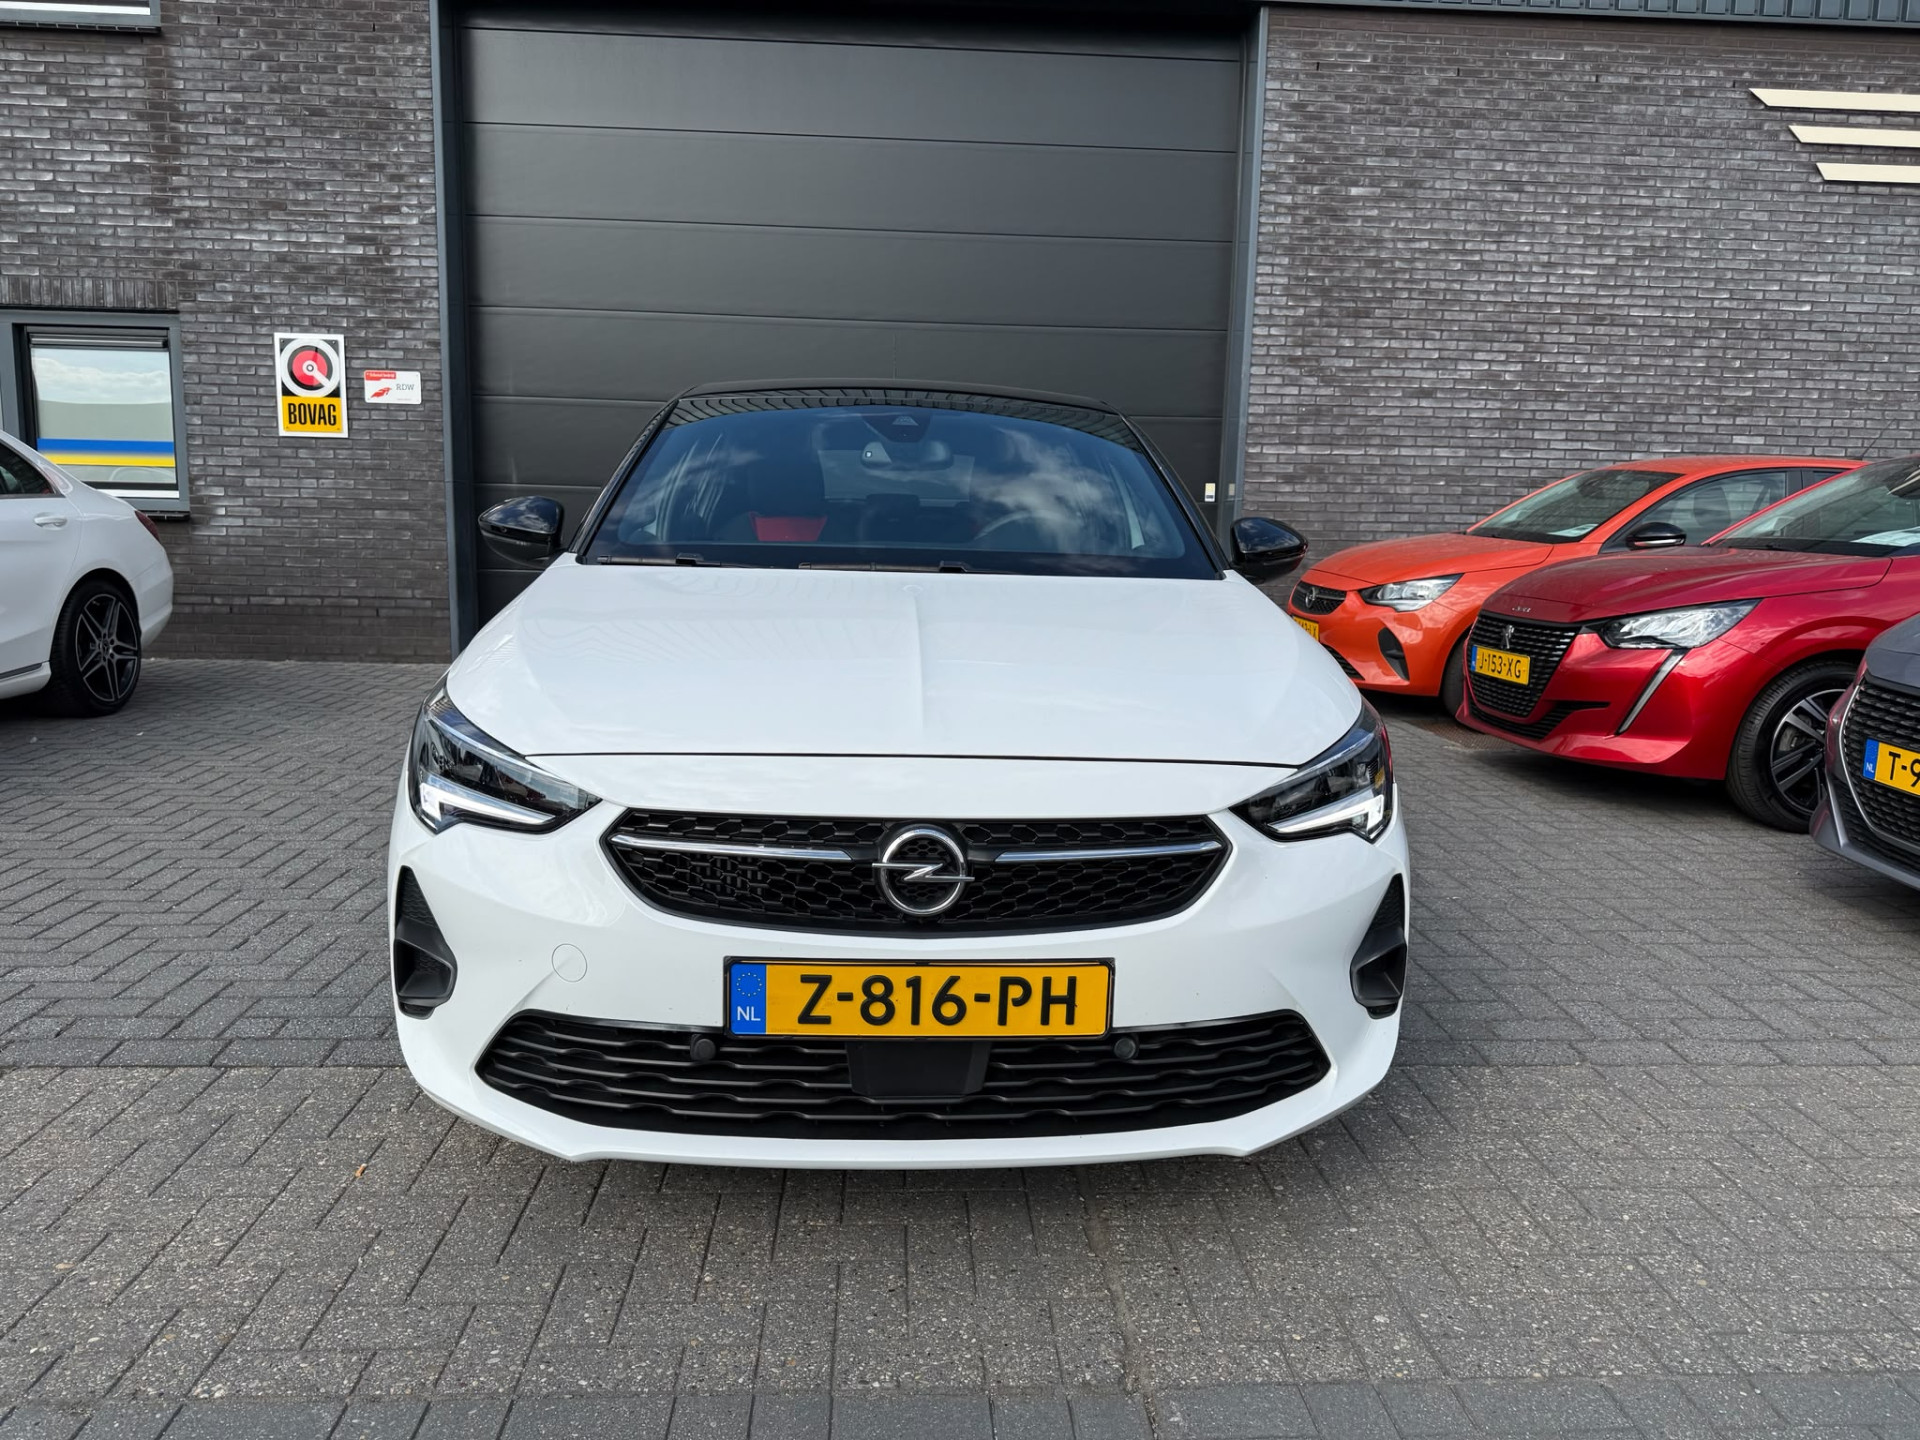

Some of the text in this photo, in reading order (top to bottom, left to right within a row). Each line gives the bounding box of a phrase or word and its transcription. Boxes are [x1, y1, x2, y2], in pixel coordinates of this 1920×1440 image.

[287, 402, 337, 426] BOVAG
[1479, 652, 1522, 679] J-153-XG
[1865, 762, 1875, 773] NL
[797, 974, 1077, 1026] Z-816-PH
[736, 1006, 761, 1021] NL
